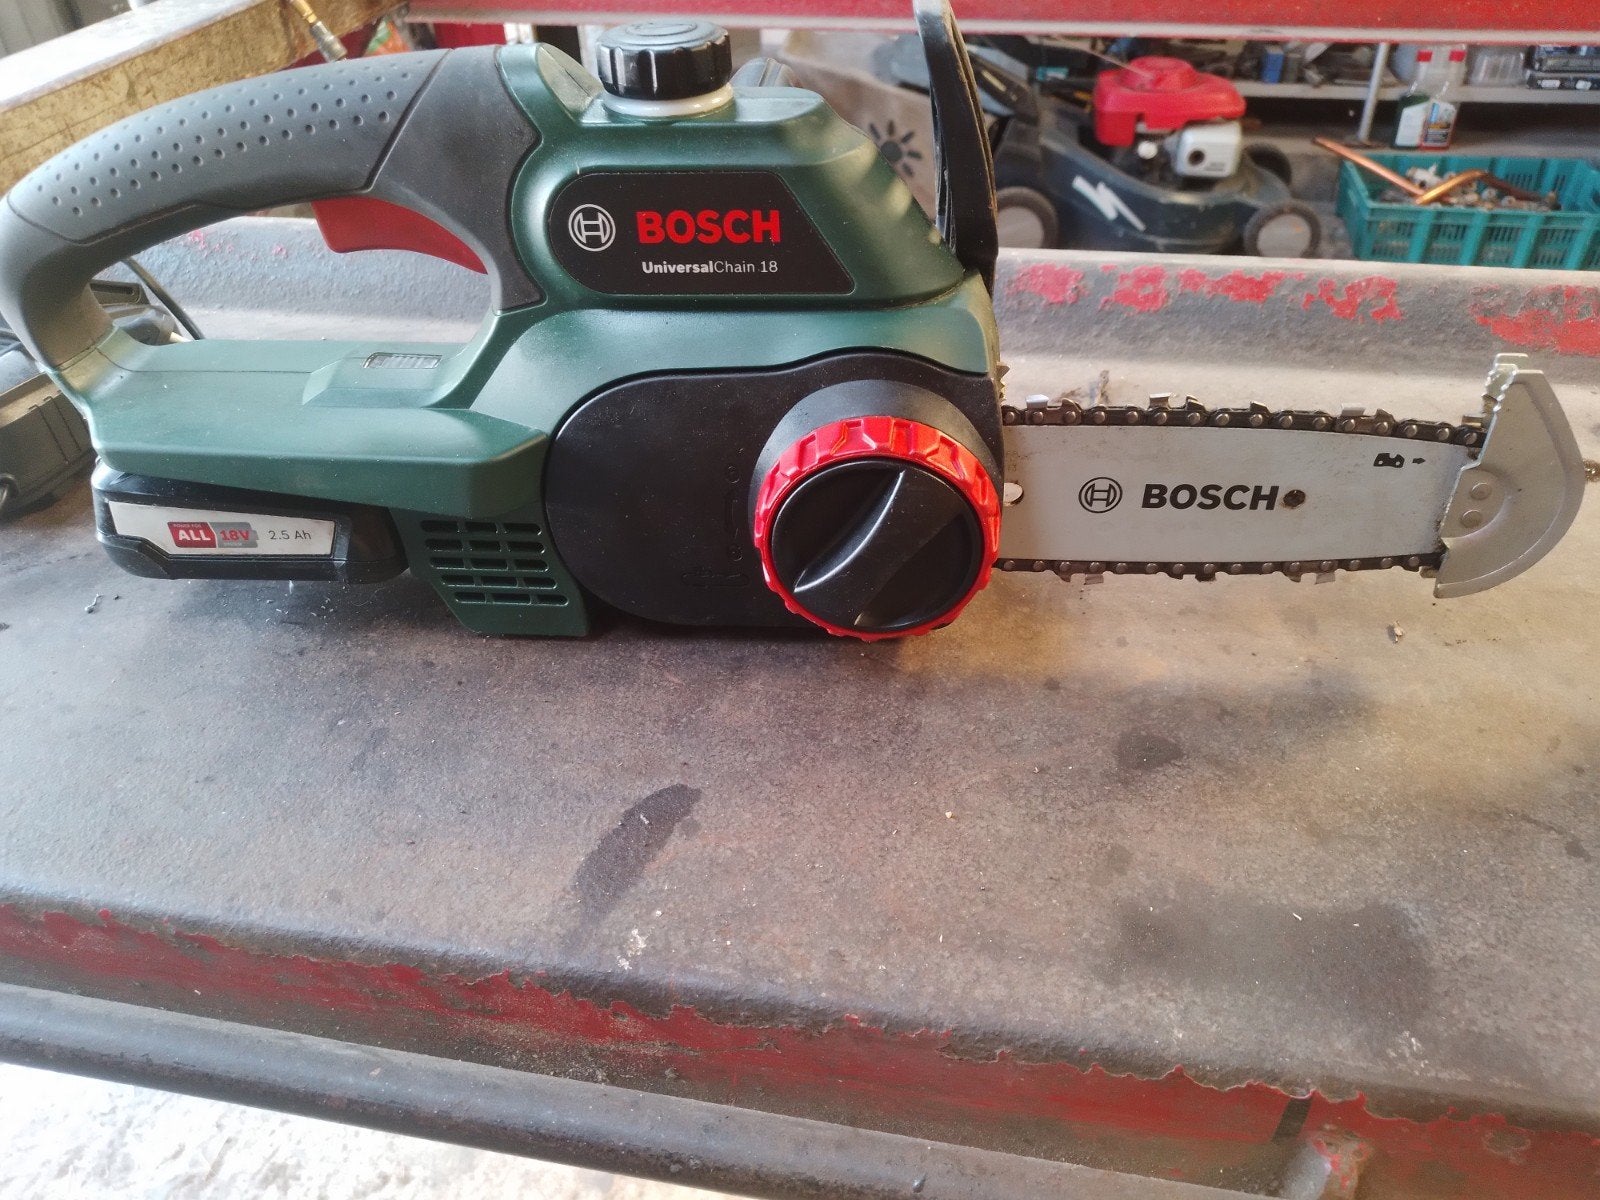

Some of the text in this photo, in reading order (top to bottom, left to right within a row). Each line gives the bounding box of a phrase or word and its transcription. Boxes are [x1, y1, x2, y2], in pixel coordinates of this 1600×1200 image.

[636, 209, 781, 244] BOSCH
[642, 260, 778, 273] UniversalChain 18
[1141, 483, 1280, 510] BOSCH
[178, 530, 211, 541] ALL
[220, 530, 250, 541] 18V
[268, 530, 312, 540] 2.5 Ah
